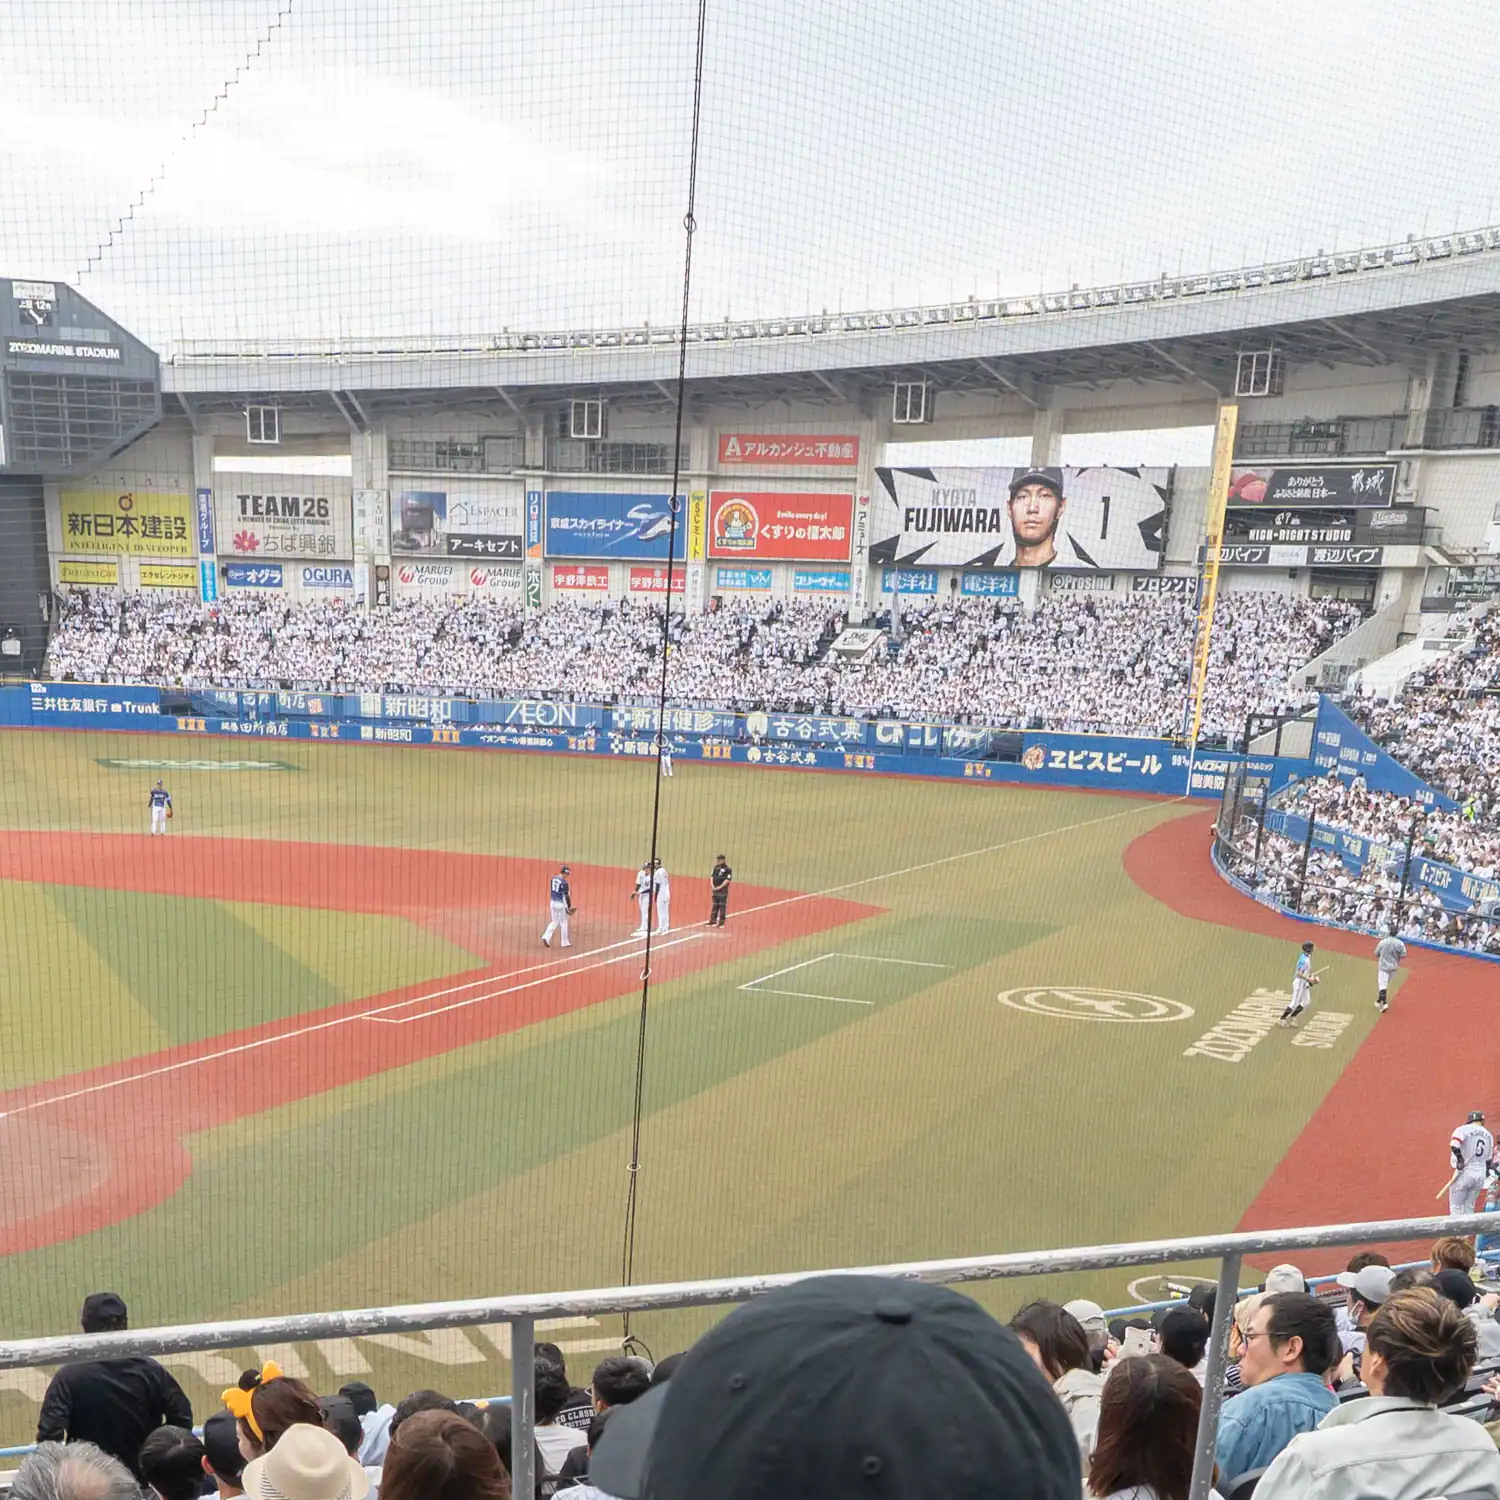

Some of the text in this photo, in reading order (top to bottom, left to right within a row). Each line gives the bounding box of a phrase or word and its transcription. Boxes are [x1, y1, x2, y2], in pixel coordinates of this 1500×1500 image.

[76, 346, 120, 359] STADIUM
[931, 488, 977, 507] KYOTA
[68, 512, 187, 540] 新日本建設
[904, 507, 1001, 533] FUJIWARA
[1100, 496, 1111, 539] 1
[760, 524, 846, 541] くすりの福太郎
[263, 533, 336, 554] ちば興銀
[451, 538, 519, 552] アーキセプト
[246, 569, 282, 584] オグラ
[303, 567, 353, 582] OGURA
[415, 565, 453, 576] MARUEI
[487, 567, 522, 577] MARUE
[417, 575, 449, 586] Group
[489, 577, 521, 589] Group
[527, 570, 540, 606] ホクト
[964, 572, 1016, 593] 電洋社
[1064, 574, 1112, 591] Prosind
[1137, 577, 1196, 593] プロシンド
[31, 697, 160, 715] 三井住友銀行 Trunk
[385, 697, 451, 720] 新昭和
[375, 726, 412, 741] 新昭和
[773, 718, 863, 740] 古谷式典
[763, 750, 817, 764] 古谷式典
